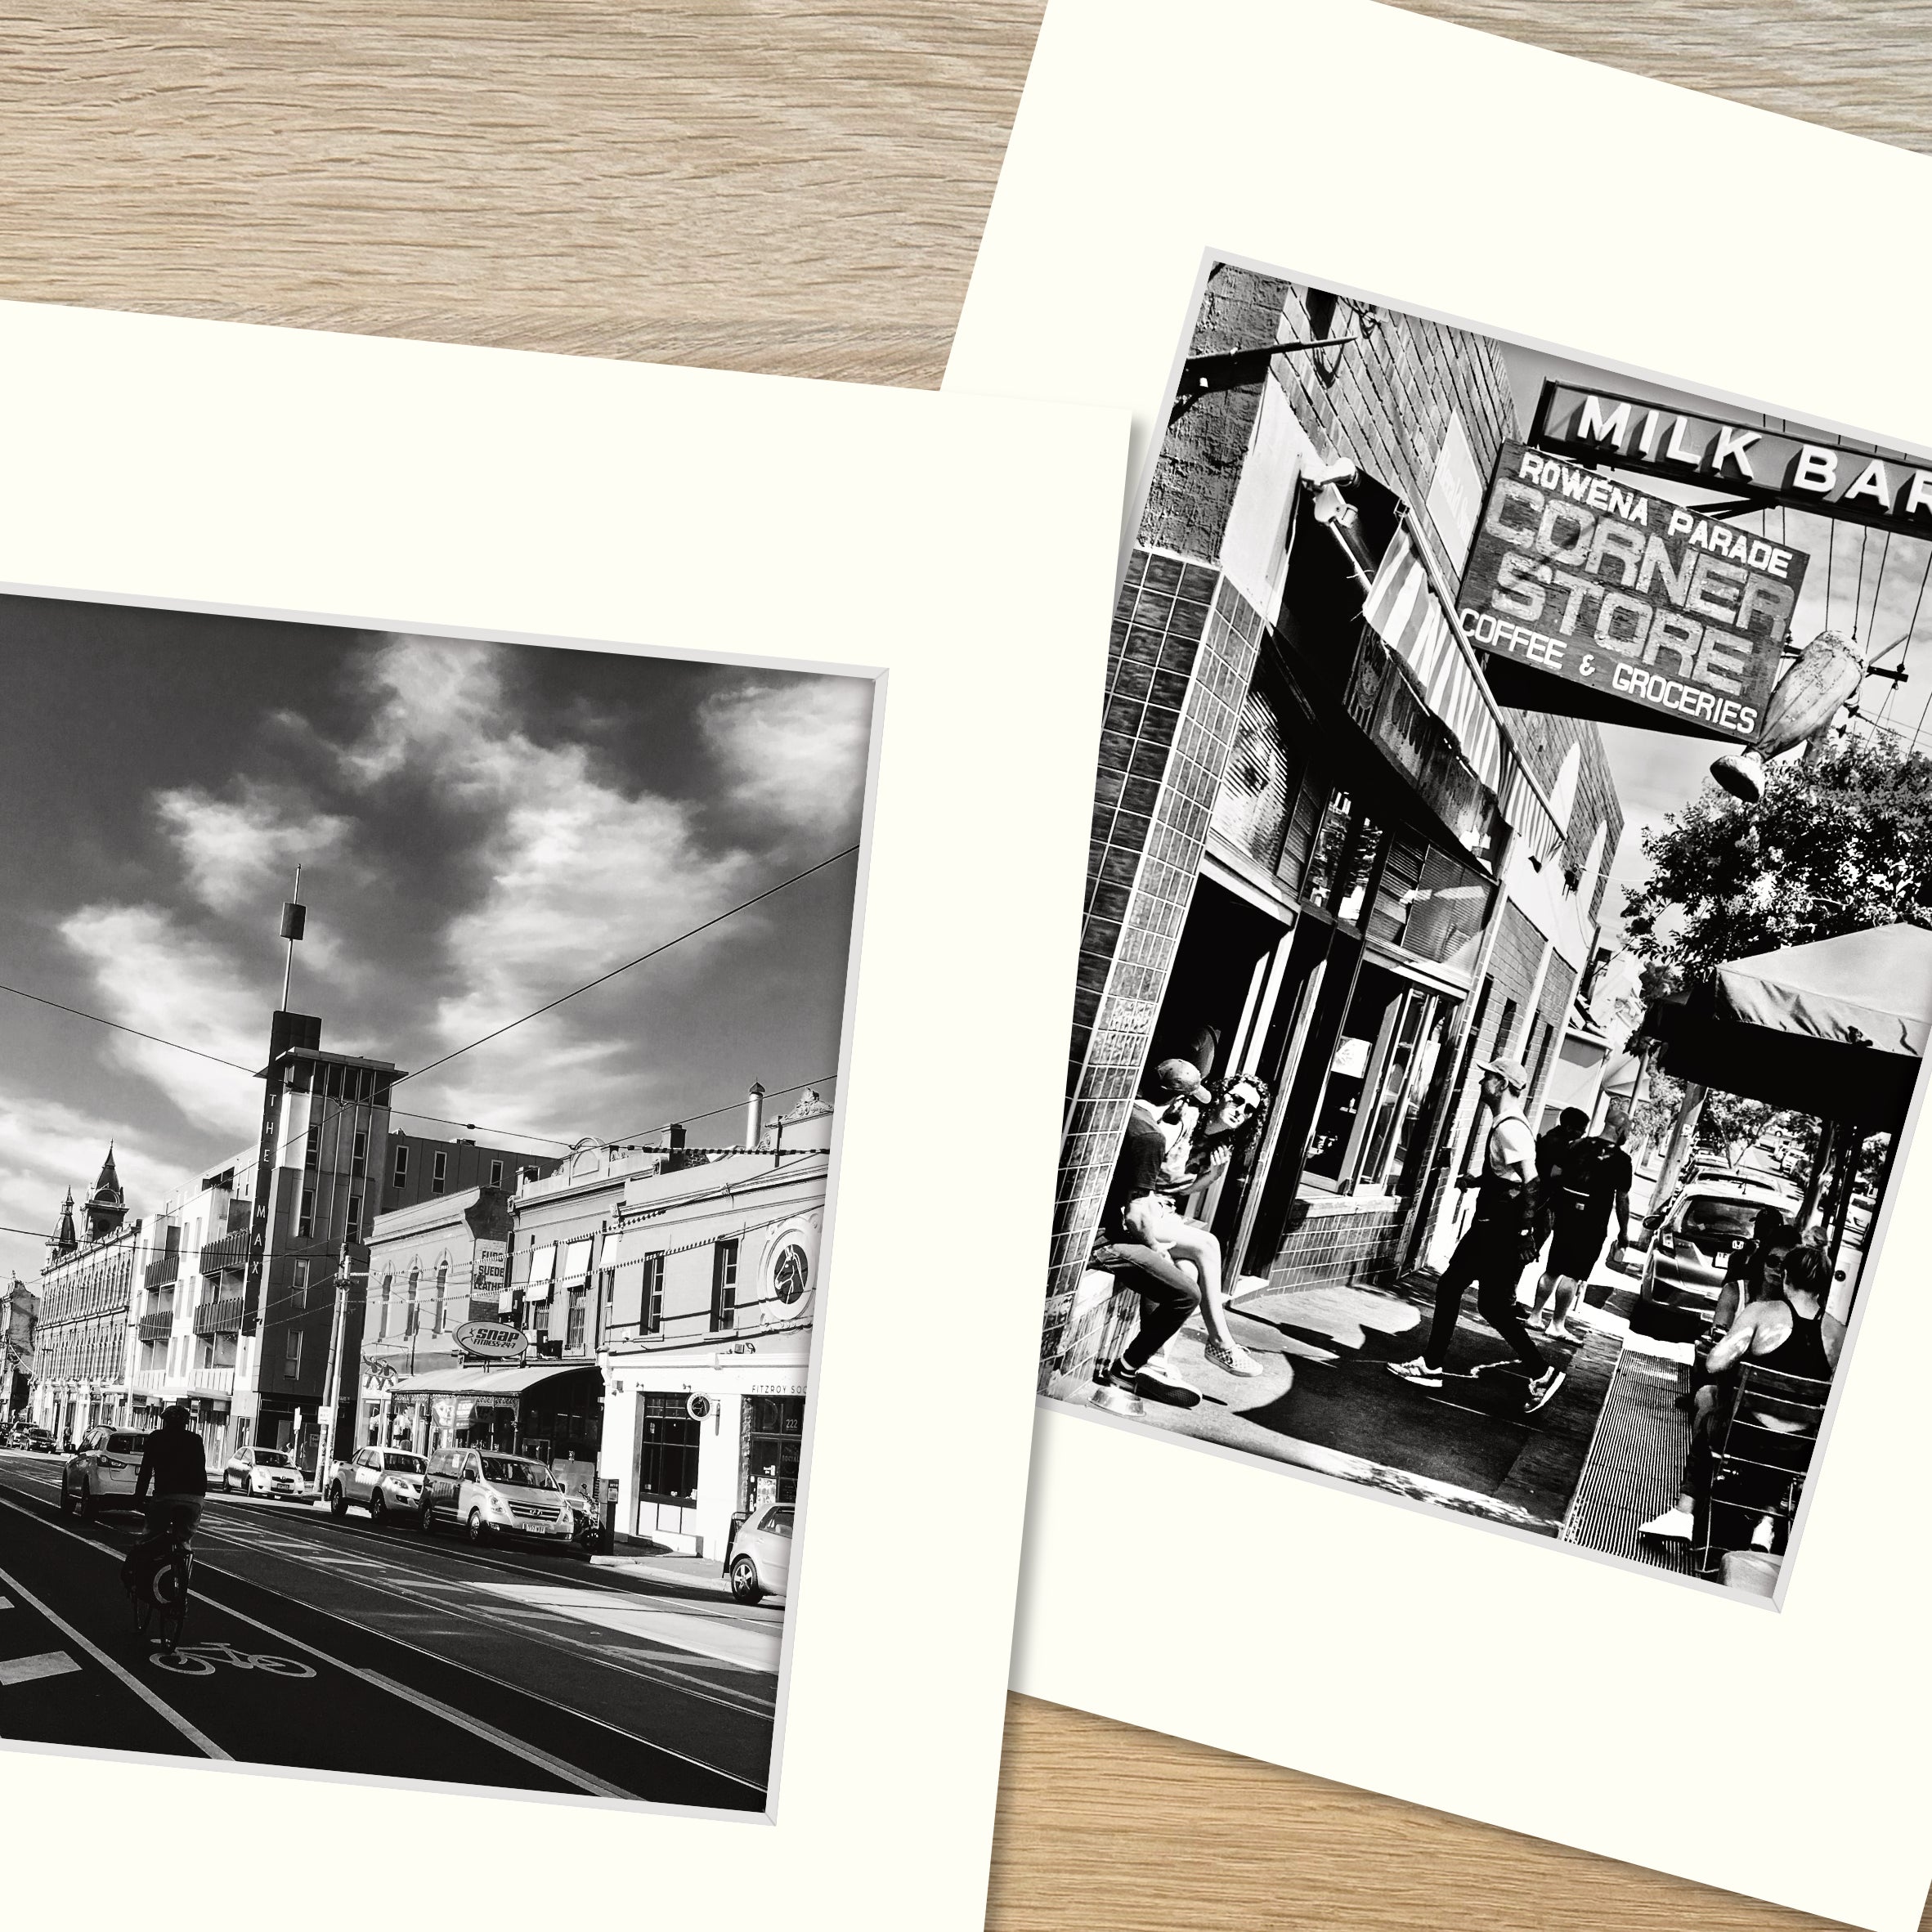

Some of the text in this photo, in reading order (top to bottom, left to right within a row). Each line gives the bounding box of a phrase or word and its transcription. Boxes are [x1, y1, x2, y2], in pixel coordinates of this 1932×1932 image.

[1577, 396, 1762, 479] MILK
[1486, 477, 1795, 641] CORNER
[1519, 452, 1792, 578] ROWENA PARADE
[1459, 608, 1758, 733] COFFEE & GROCERIES
[1491, 550, 1754, 695] STORE
[251, 1094, 277, 1274] THE MAX
[479, 1266, 504, 1277] SUEDE
[751, 1385, 786, 1393] FITZROY
[786, 1419, 798, 1428] 222
